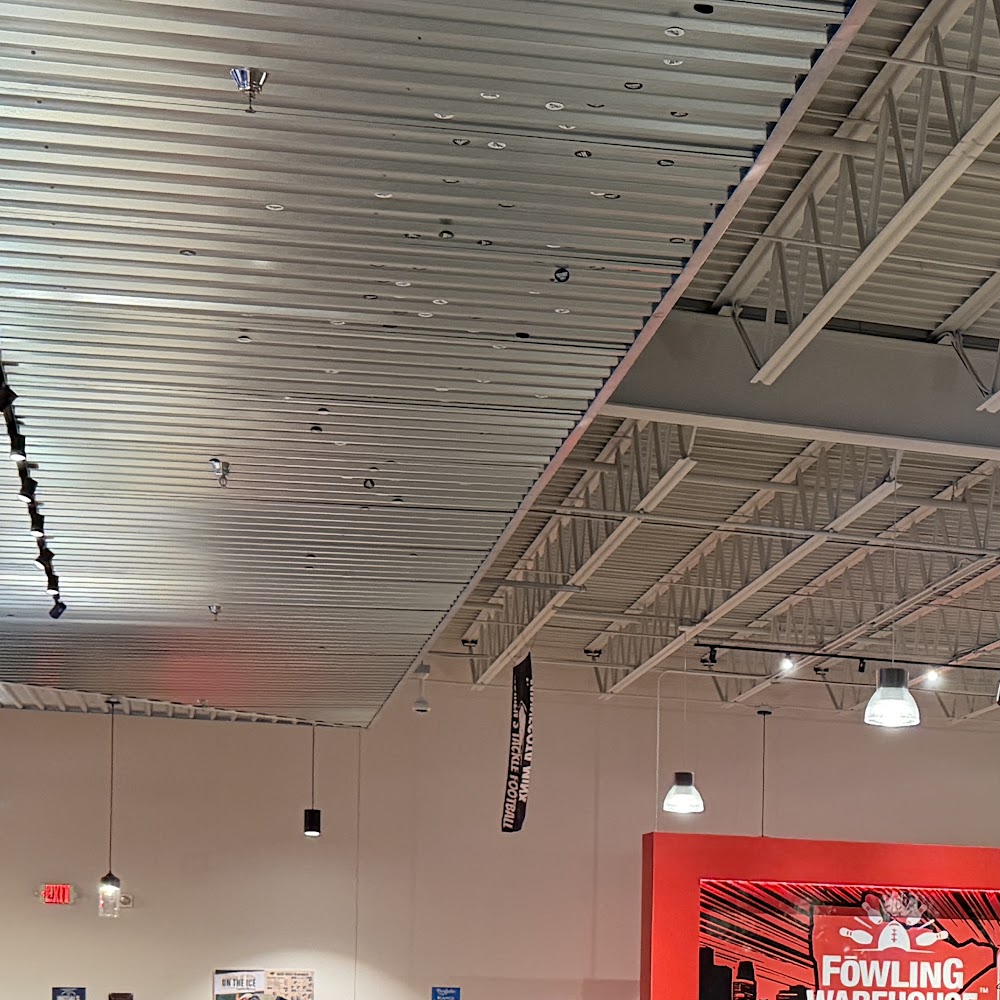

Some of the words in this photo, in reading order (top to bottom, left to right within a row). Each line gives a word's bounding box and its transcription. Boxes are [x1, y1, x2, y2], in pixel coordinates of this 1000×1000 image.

[502, 773, 520, 830] FOOTBALL
[45, 885, 71, 902] EXIT
[222, 978, 231, 987] ON
[232, 979, 244, 987] THE
[245, 978, 256, 987] ICE
